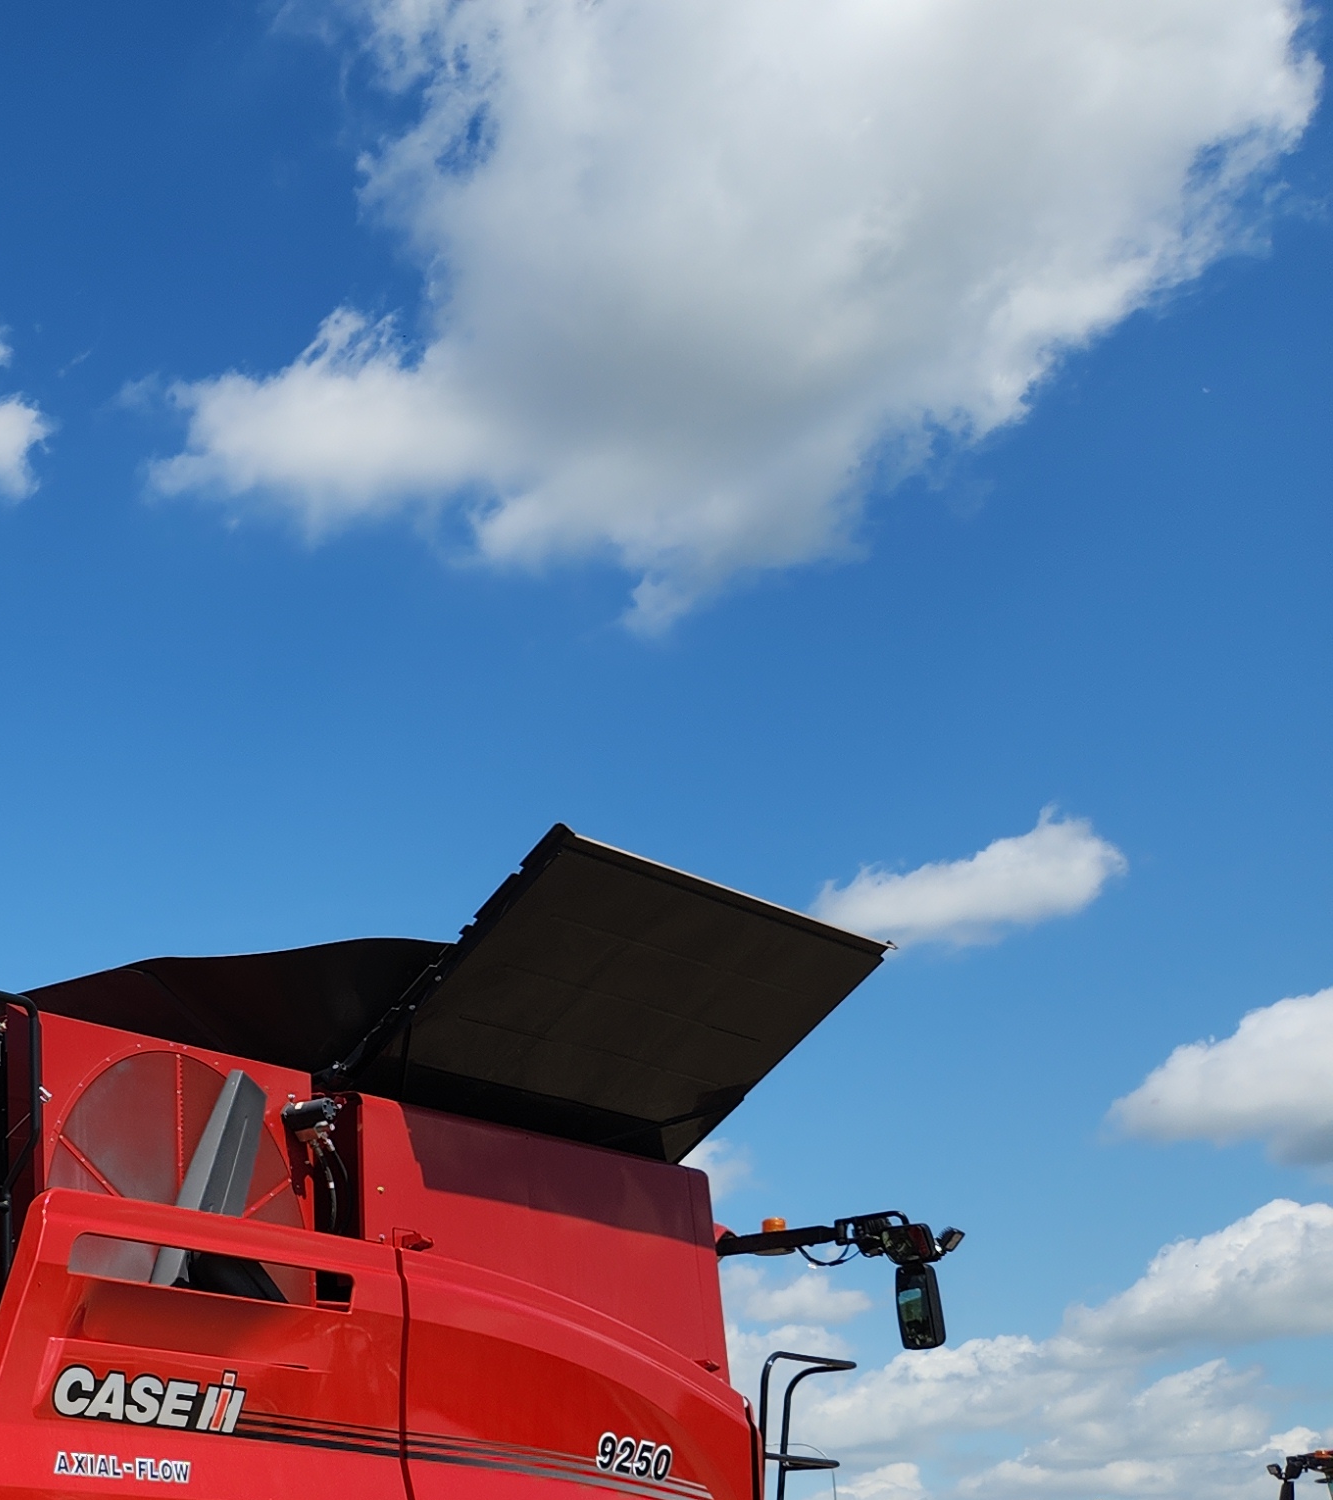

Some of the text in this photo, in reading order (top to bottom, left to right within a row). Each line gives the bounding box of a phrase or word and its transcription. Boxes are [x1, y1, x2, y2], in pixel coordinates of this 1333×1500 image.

[54, 1366, 200, 1428] CASE
[54, 1450, 192, 1484] AXIAL-FLOW
[595, 1431, 673, 1482] 9250
